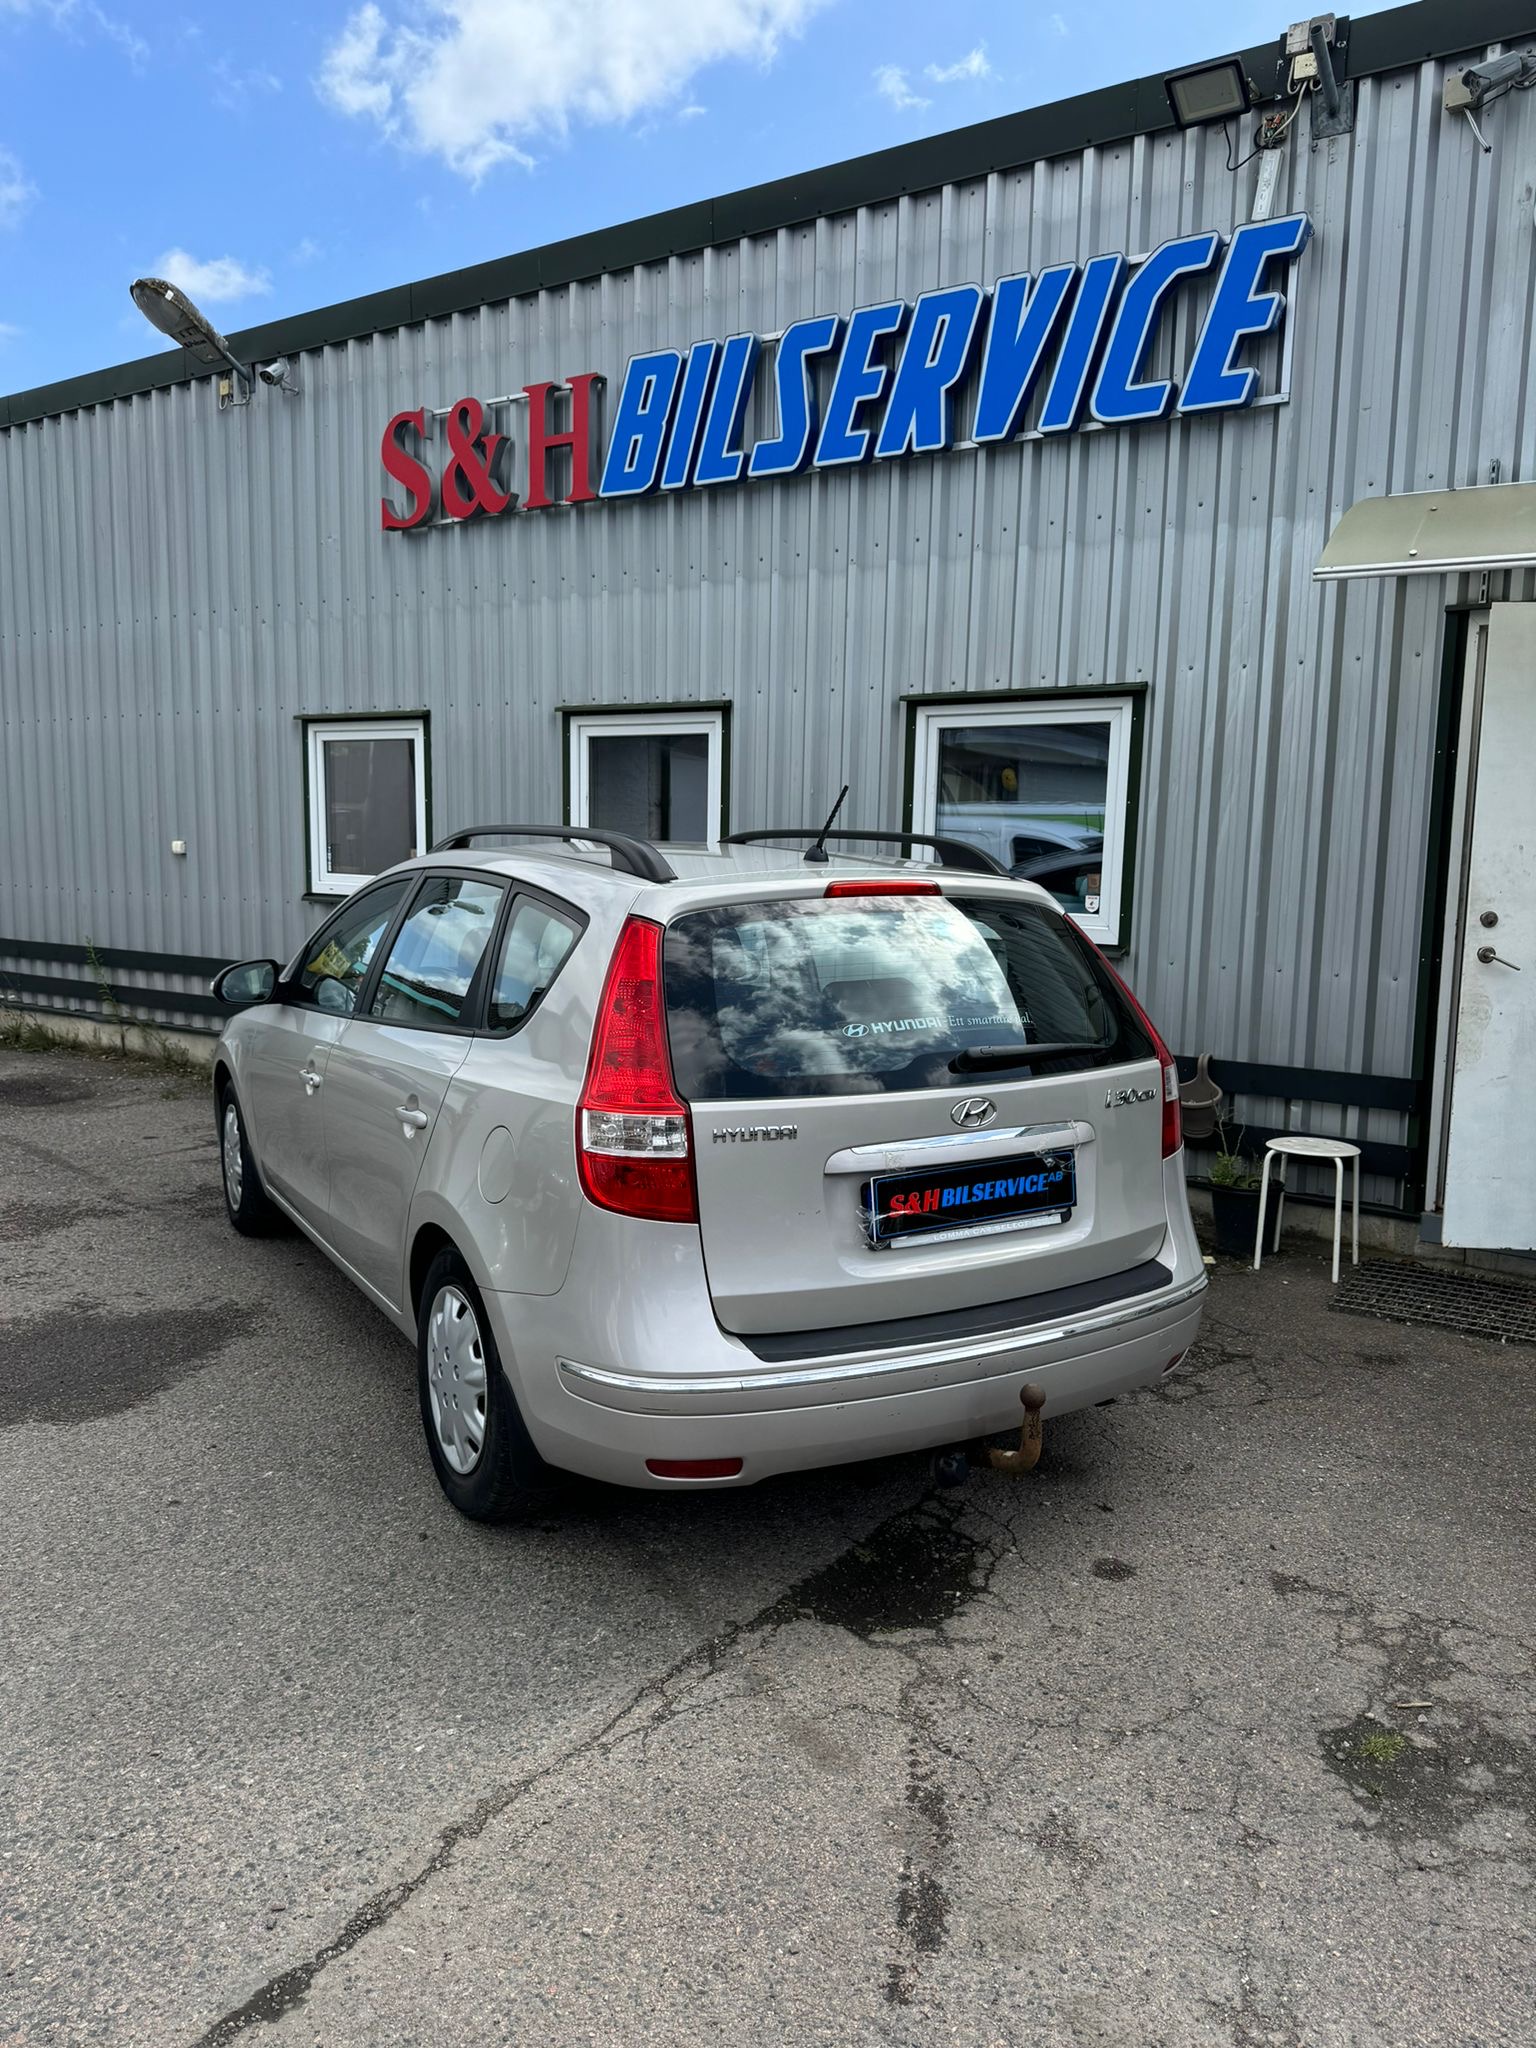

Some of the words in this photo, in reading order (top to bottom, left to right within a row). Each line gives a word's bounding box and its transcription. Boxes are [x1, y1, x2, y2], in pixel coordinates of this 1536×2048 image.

[381, 371, 608, 532] S&H
[599, 212, 1312, 500] BILSERVICE
[871, 1016, 943, 1034] HYUNDAI
[712, 1124, 798, 1144] HYUNDAI
[890, 1188, 941, 1218] S&H
[941, 1172, 1049, 1208] BILSERVICE
[1048, 1170, 1064, 1183] AB
